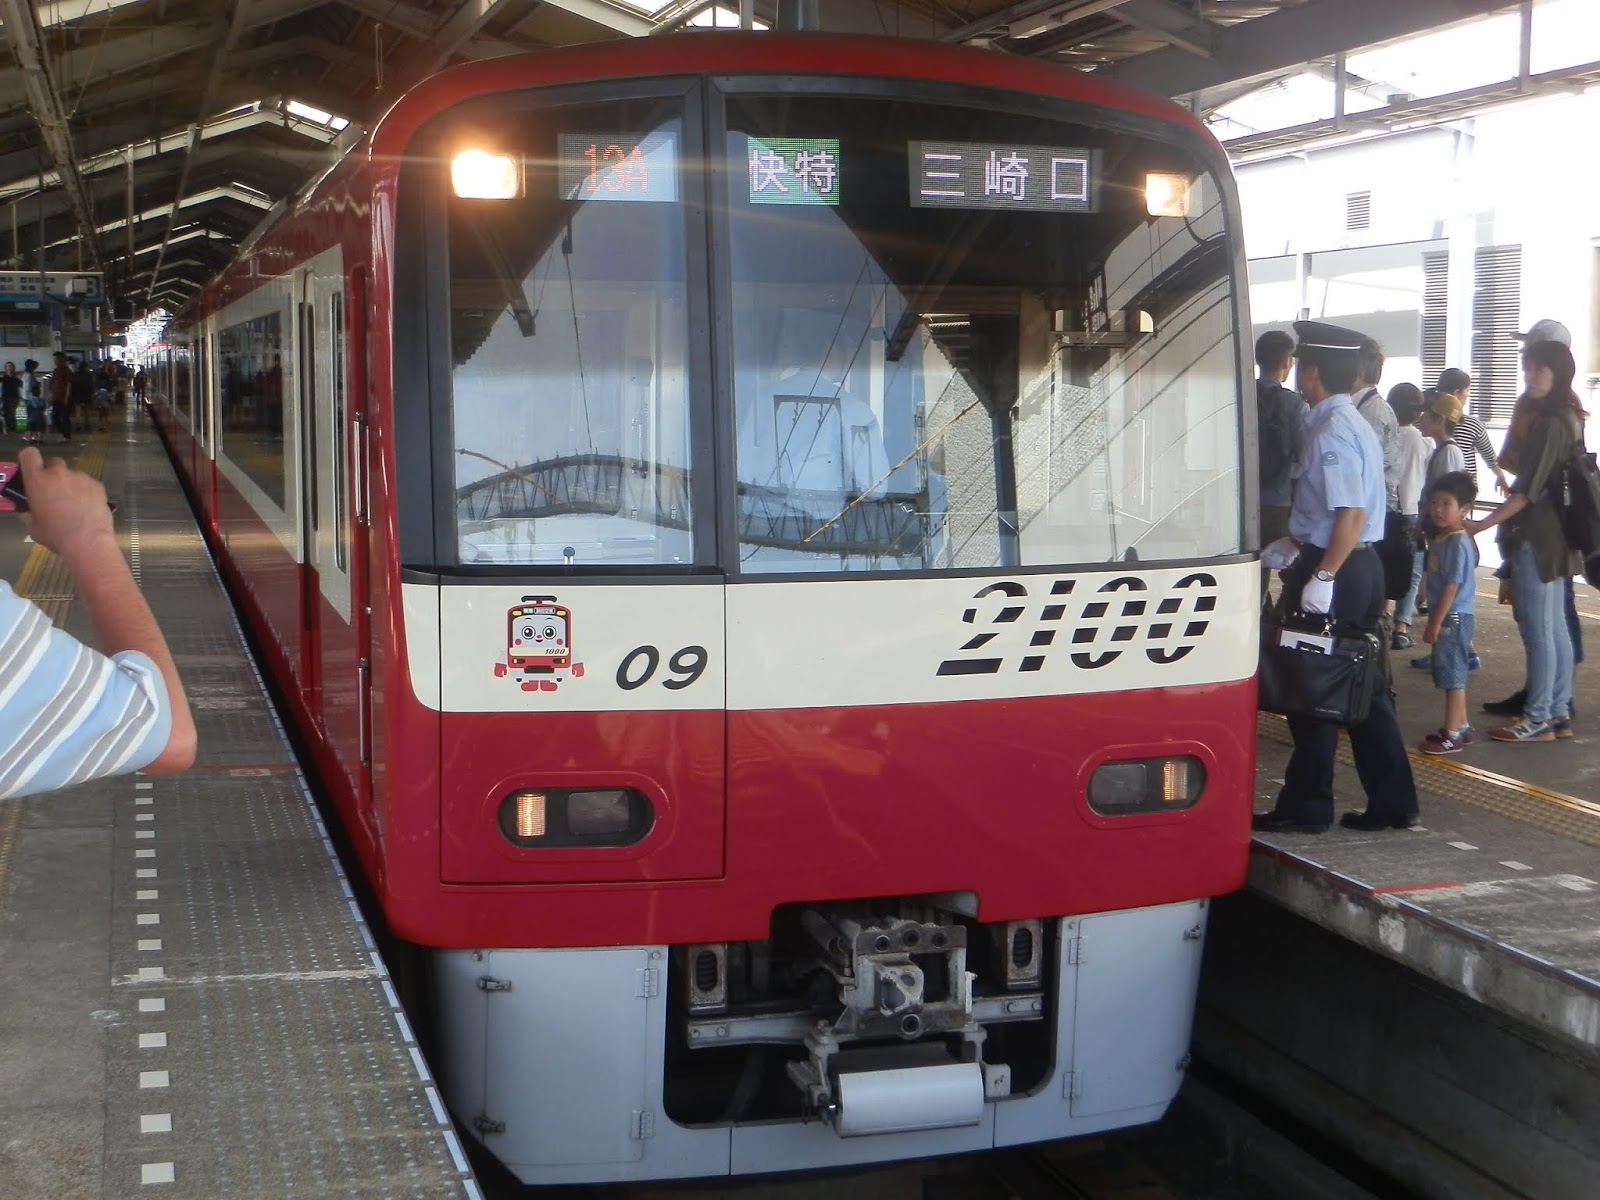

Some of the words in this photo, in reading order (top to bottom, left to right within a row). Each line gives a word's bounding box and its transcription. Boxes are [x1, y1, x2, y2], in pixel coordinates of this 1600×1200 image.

[583, 144, 648, 193] 13A
[749, 148, 837, 193] 快特
[920, 150, 1088, 202] 三崎口
[935, 572, 1218, 677] 2100
[615, 644, 709, 691] 09
